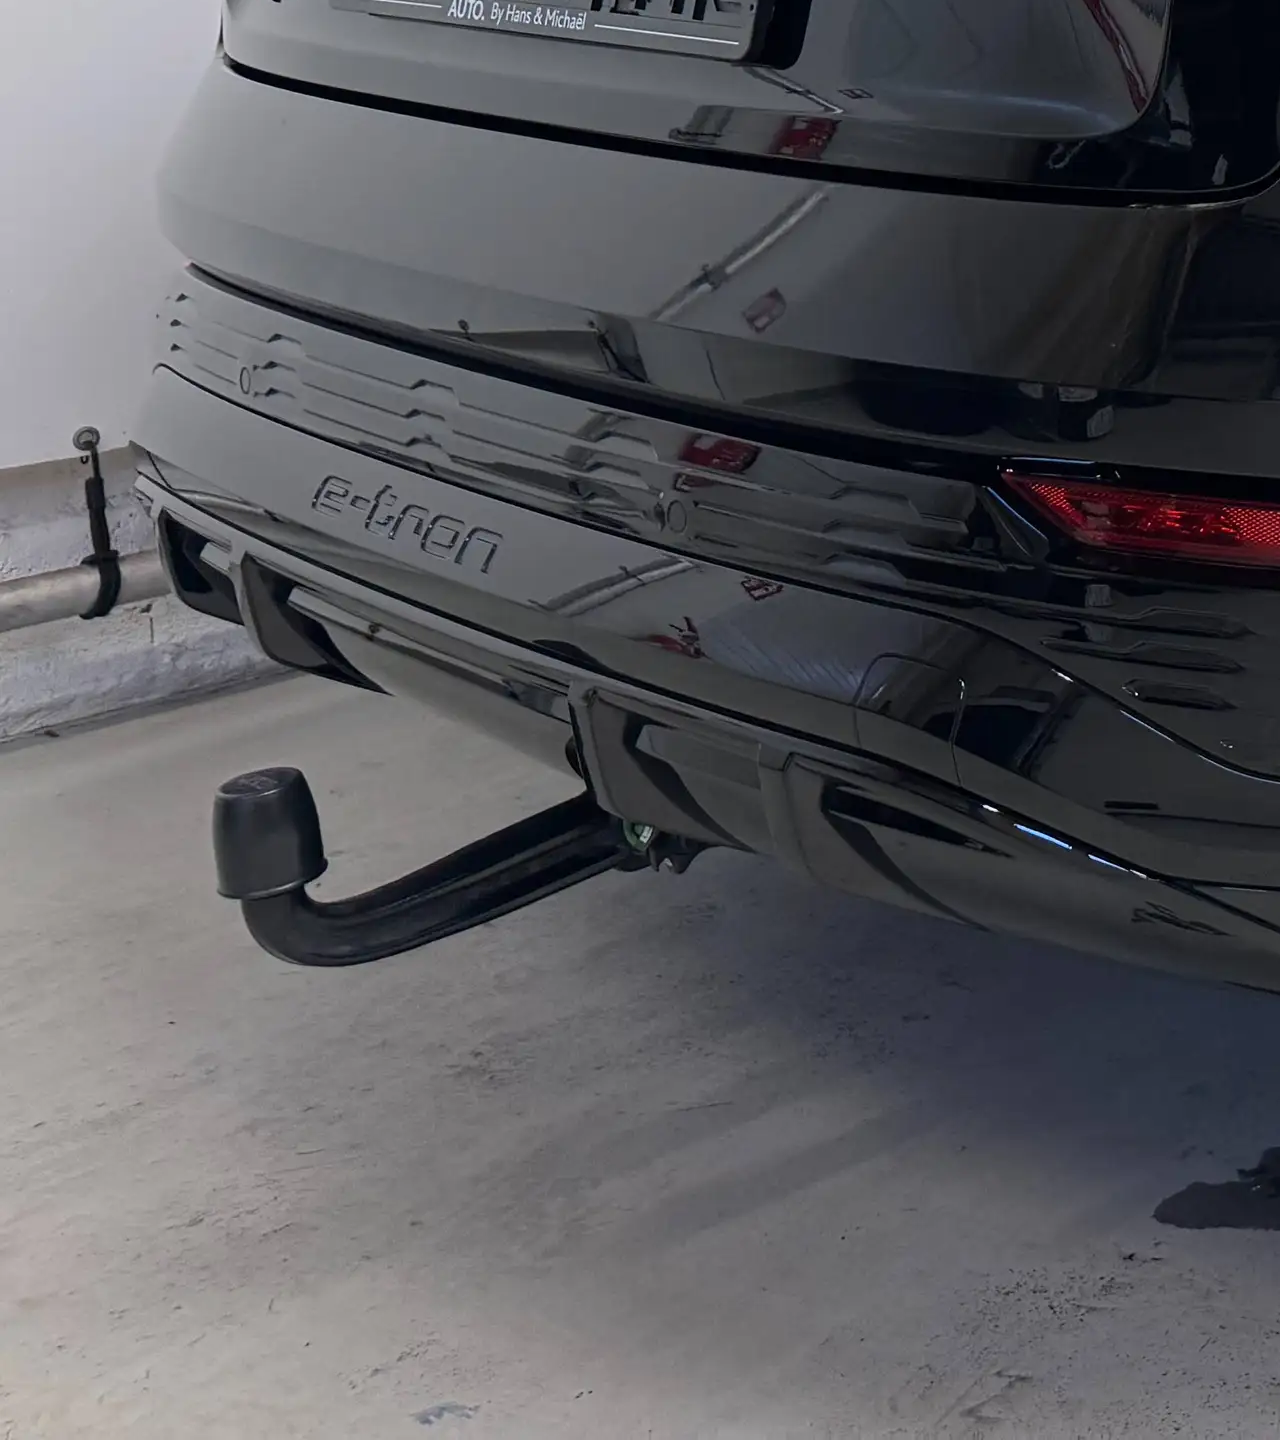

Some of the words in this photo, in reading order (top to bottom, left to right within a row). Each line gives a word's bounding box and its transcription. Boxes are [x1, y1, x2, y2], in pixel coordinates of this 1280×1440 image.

[490, 3, 505, 25] By
[506, 4, 532, 24] Hans
[533, 6, 543, 25] &
[544, 8, 588, 30] Michaël
[311, 474, 505, 574] e-tron
